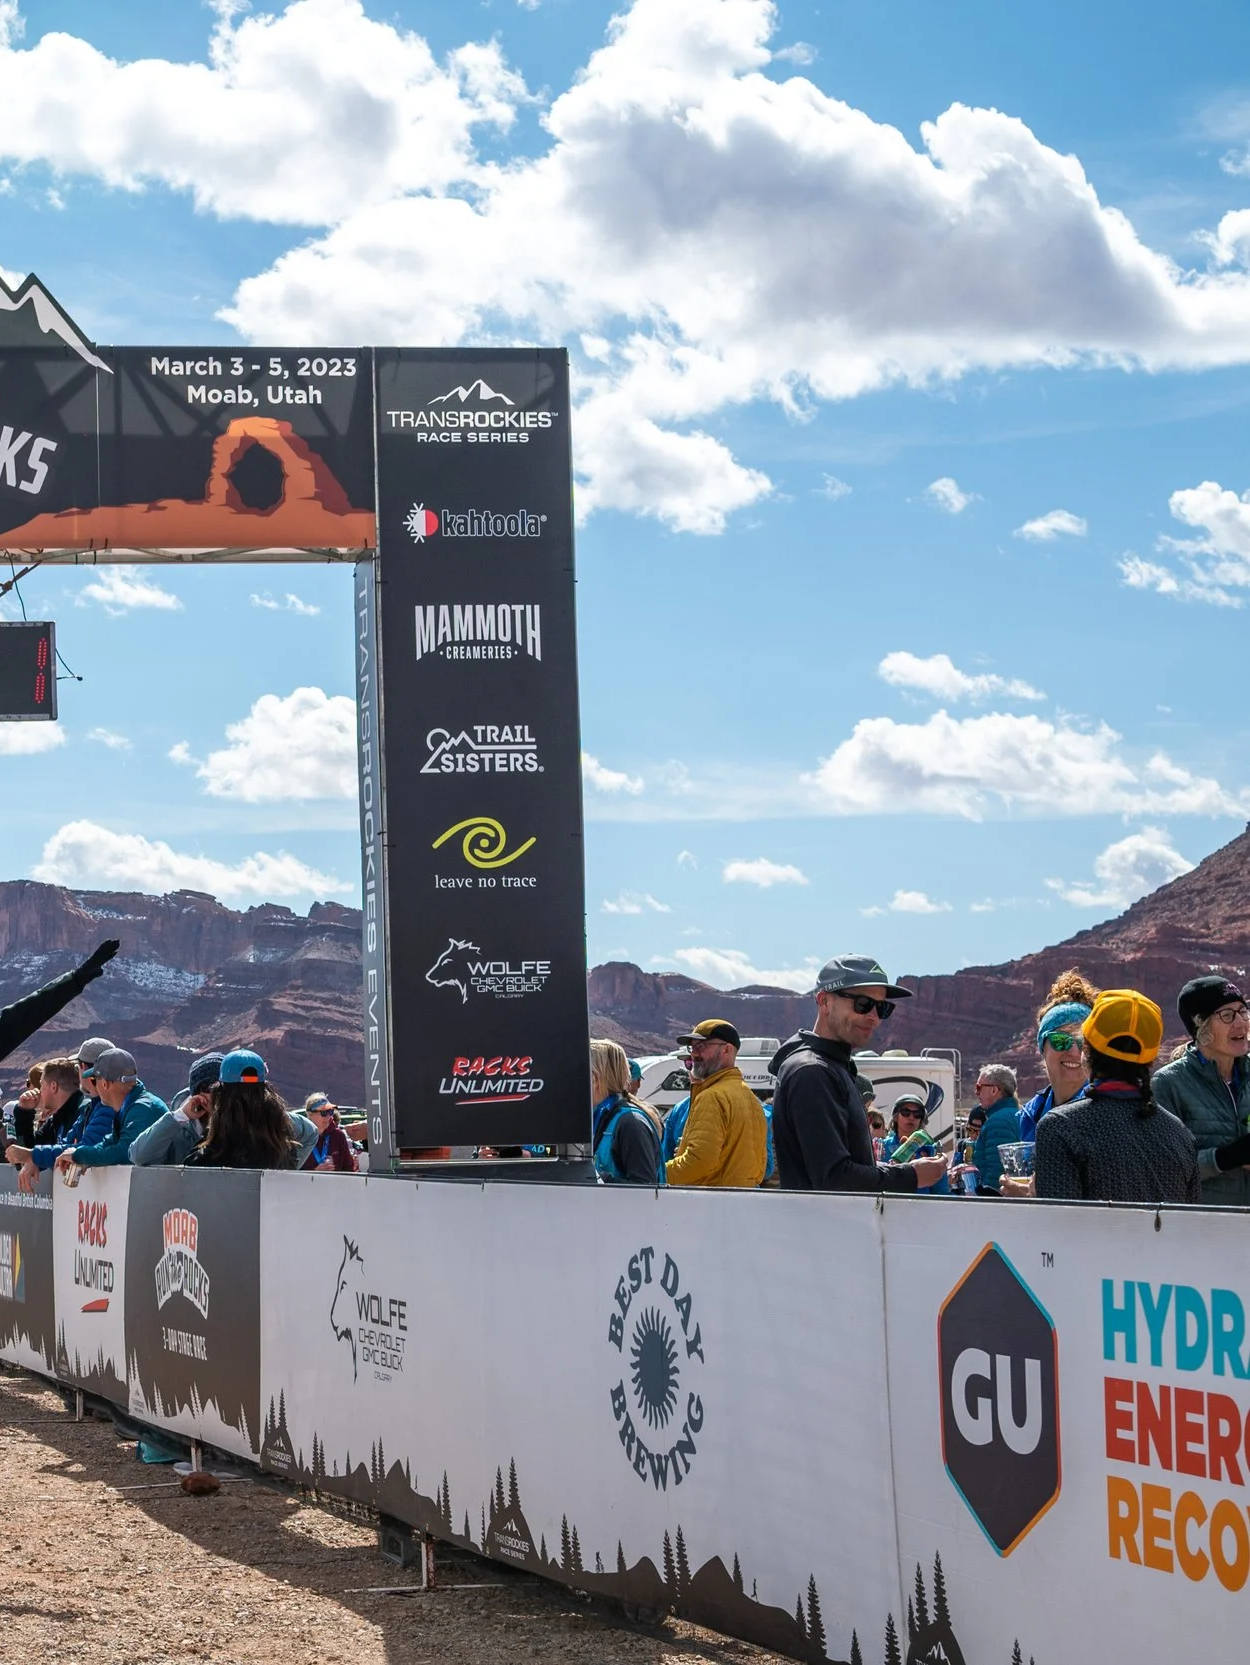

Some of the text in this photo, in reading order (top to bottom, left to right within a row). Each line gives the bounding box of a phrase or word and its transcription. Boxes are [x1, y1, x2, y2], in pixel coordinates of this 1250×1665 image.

[151, 356, 222, 376] March
[230, 357, 245, 376] 3
[269, 358, 291, 380] 5,
[297, 358, 357, 377] 2023
[187, 385, 322, 408] Moab, Utah
[417, 432, 530, 443] RACE SERIES
[414, 603, 542, 662] MAMMOTH
[445, 645, 513, 660] CREAMERIES
[473, 725, 536, 743] TRAIL
[358, 576, 377, 952] TRANSROCKIES
[434, 874, 537, 889] leave no trace
[467, 961, 552, 976] WOLFE
[470, 976, 548, 985] CHEVROLET
[476, 984, 542, 993] GMC BUICK
[824, 980, 845, 991] TRAIL
[367, 968, 383, 1145] EVENTS
[452, 1056, 534, 1077] RACKS
[439, 1078, 544, 1094] UNLIMITED
[77, 1199, 109, 1249] RACKS
[164, 1210, 198, 1252] MOAB
[74, 1249, 115, 1293] UNLIMITED
[356, 1291, 407, 1332] WOLFE
[608, 1246, 705, 1364] BEST DAY
[358, 1327, 406, 1353] CHEVROLET
[1102, 1279, 1250, 1380] HYDR
[363, 1346, 403, 1372] GMC BUICK
[951, 1347, 1043, 1455] GU
[610, 1379, 704, 1492] BREWING
[1104, 1376, 1250, 1486] ENER
[1107, 1475, 1250, 1593] RECO
